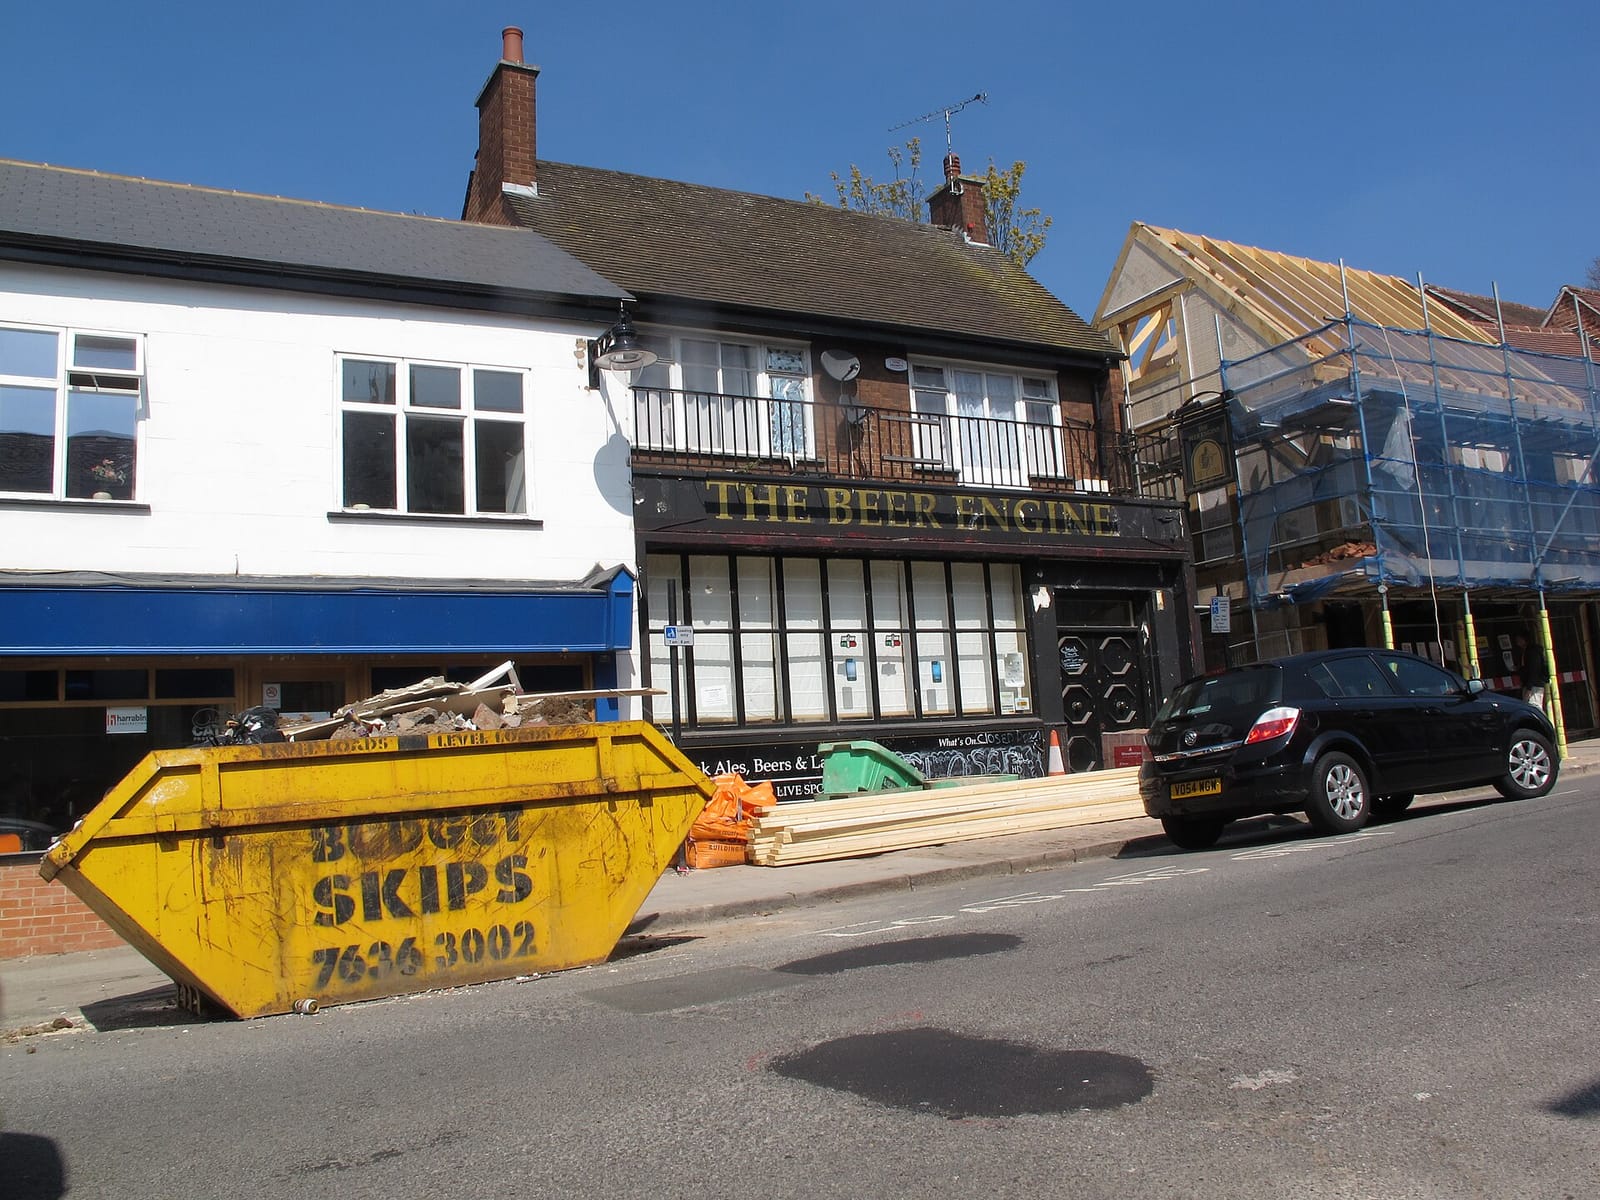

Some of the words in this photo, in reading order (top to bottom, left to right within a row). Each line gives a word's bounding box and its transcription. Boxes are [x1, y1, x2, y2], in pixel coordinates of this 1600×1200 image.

[706, 480, 809, 523] THE
[823, 487, 943, 529] BEER
[951, 494, 1118, 537] ENGINE
[326, 738, 389, 754] LOADS
[437, 732, 488, 747] LEVEL
[939, 737, 964, 747] What's
[714, 760, 750, 776] Ales,
[753, 758, 792, 773] Beers
[795, 756, 807, 770] &
[776, 785, 803, 797] LIVE
[311, 805, 524, 863] BUDGET
[313, 854, 533, 928] SKIPS
[313, 936, 424, 989] 7636
[435, 919, 537, 968] 3002
